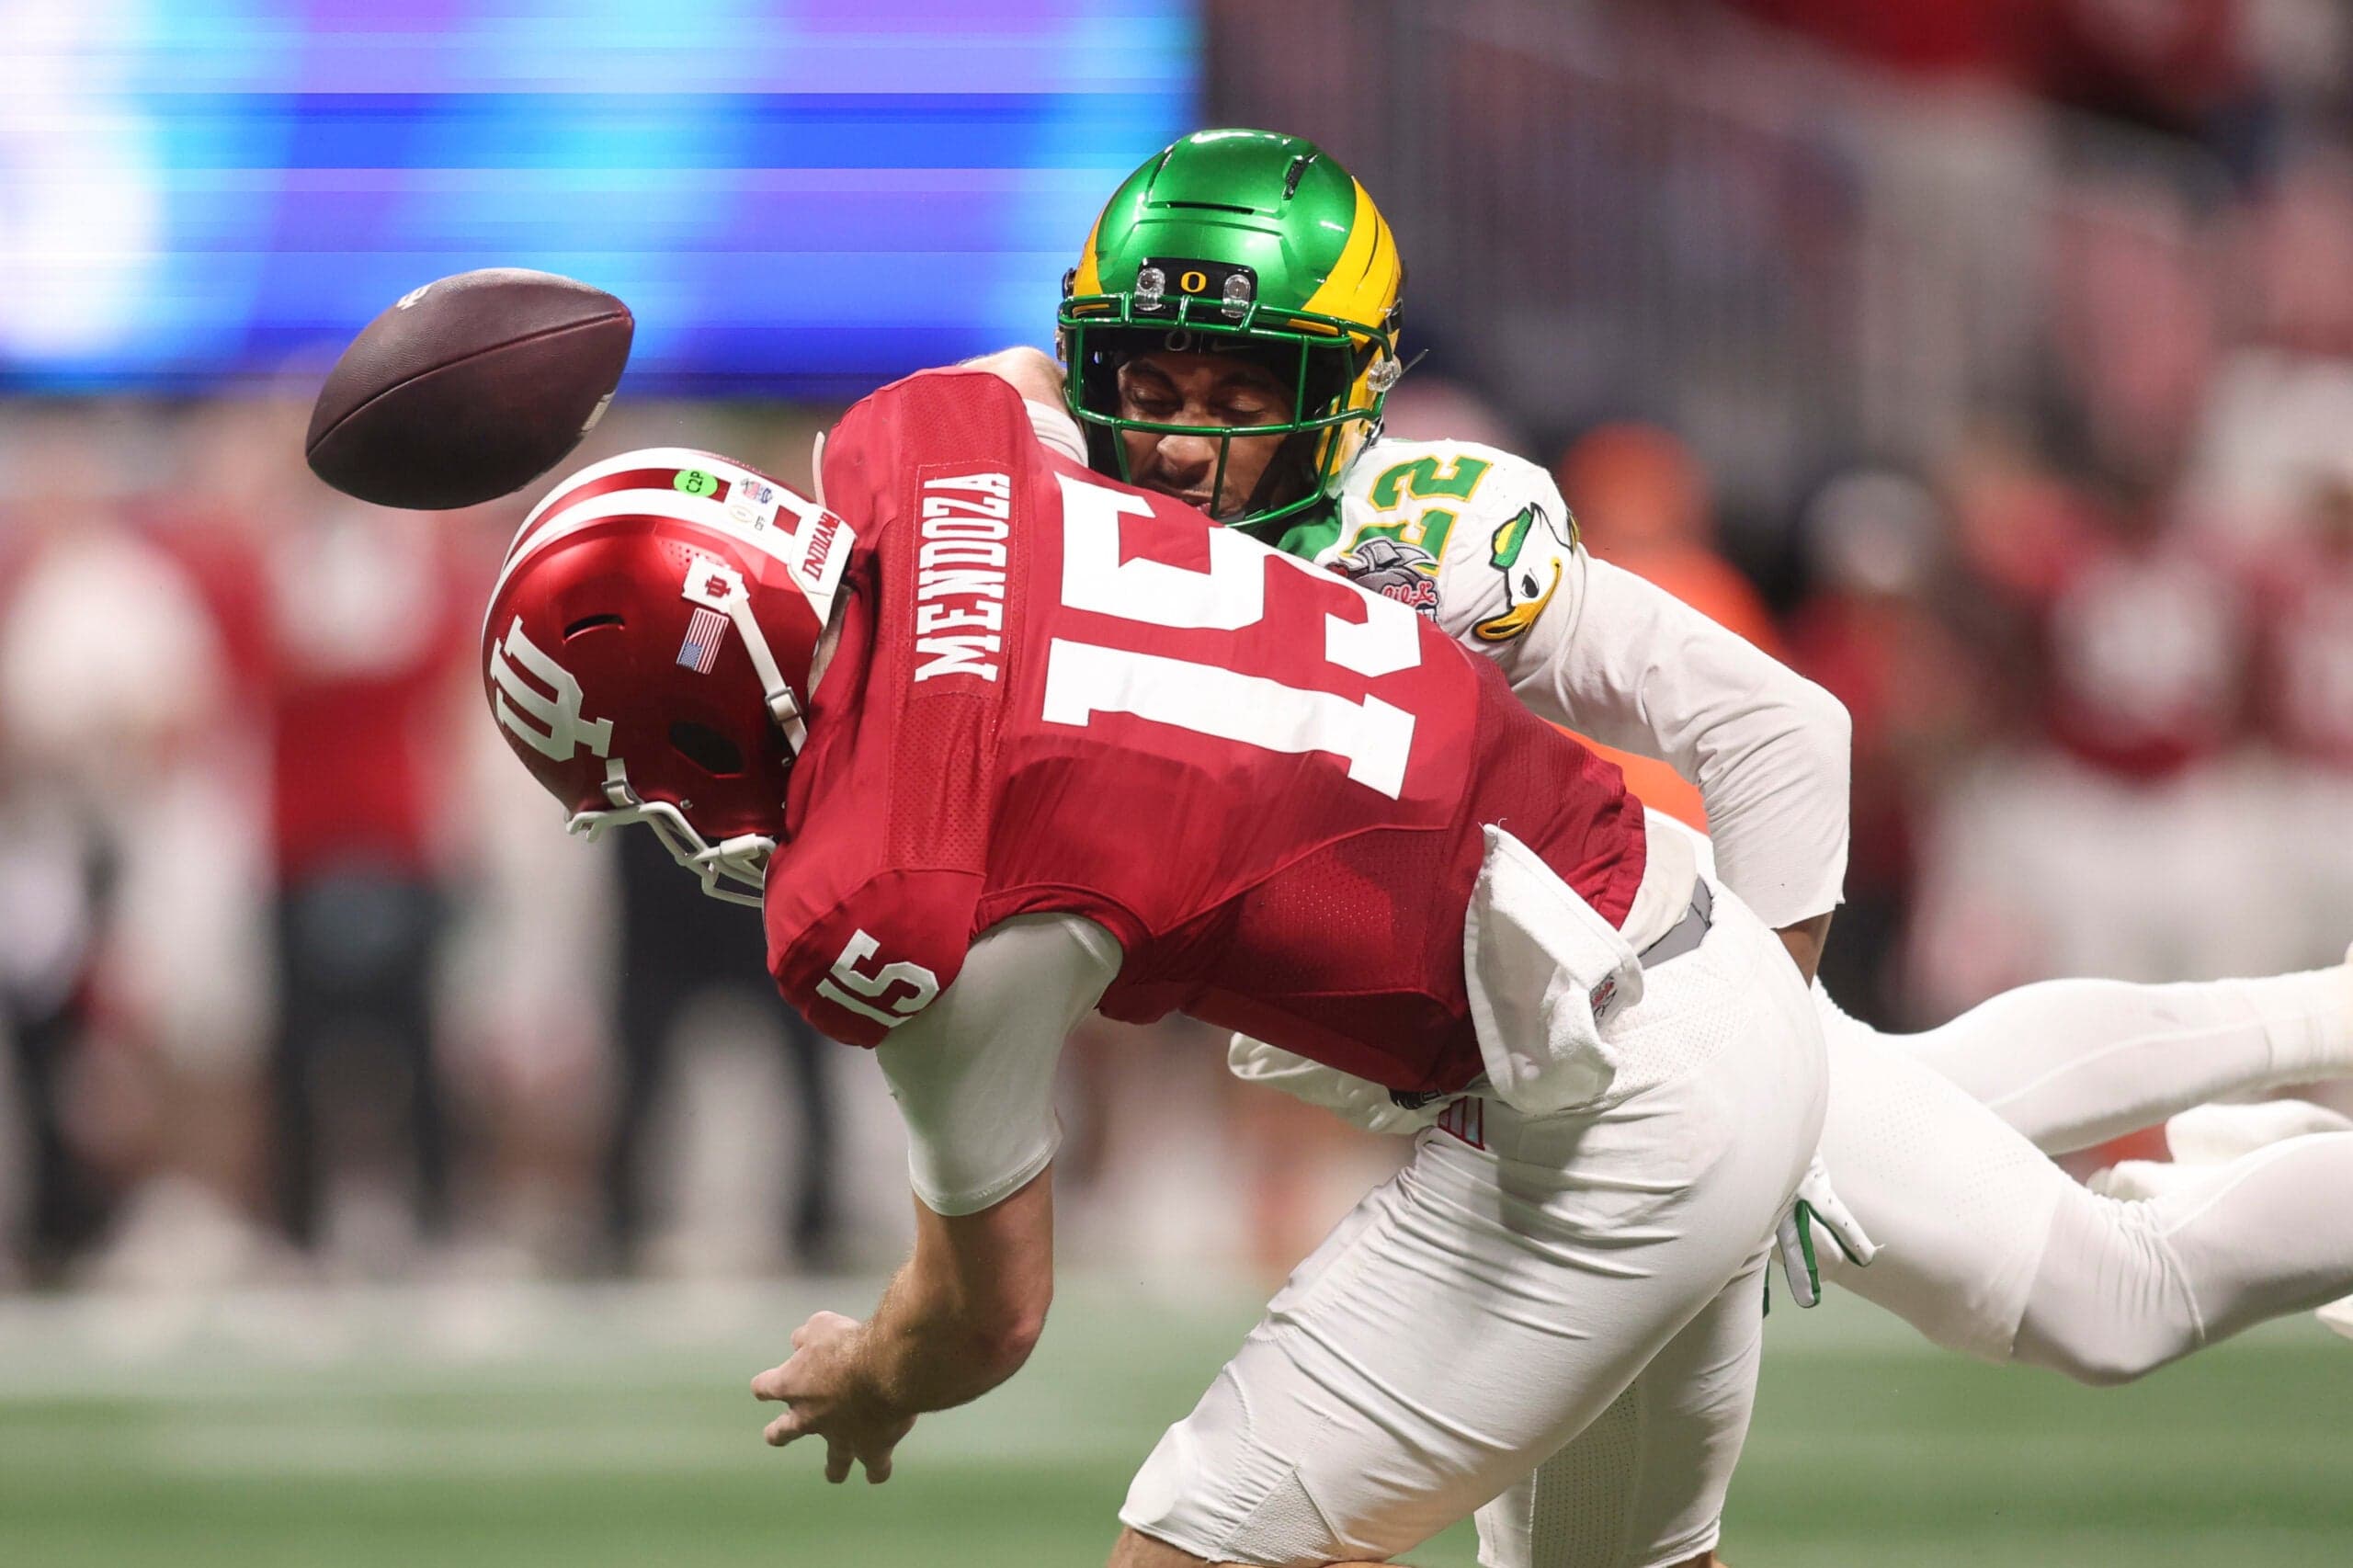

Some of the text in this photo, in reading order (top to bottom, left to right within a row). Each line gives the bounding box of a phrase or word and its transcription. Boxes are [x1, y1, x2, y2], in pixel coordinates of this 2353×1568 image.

[686, 471, 704, 494] C2P
[915, 472, 1010, 682] MENDOZA
[1042, 471, 1422, 800] 15
[815, 928, 940, 1028] 15
